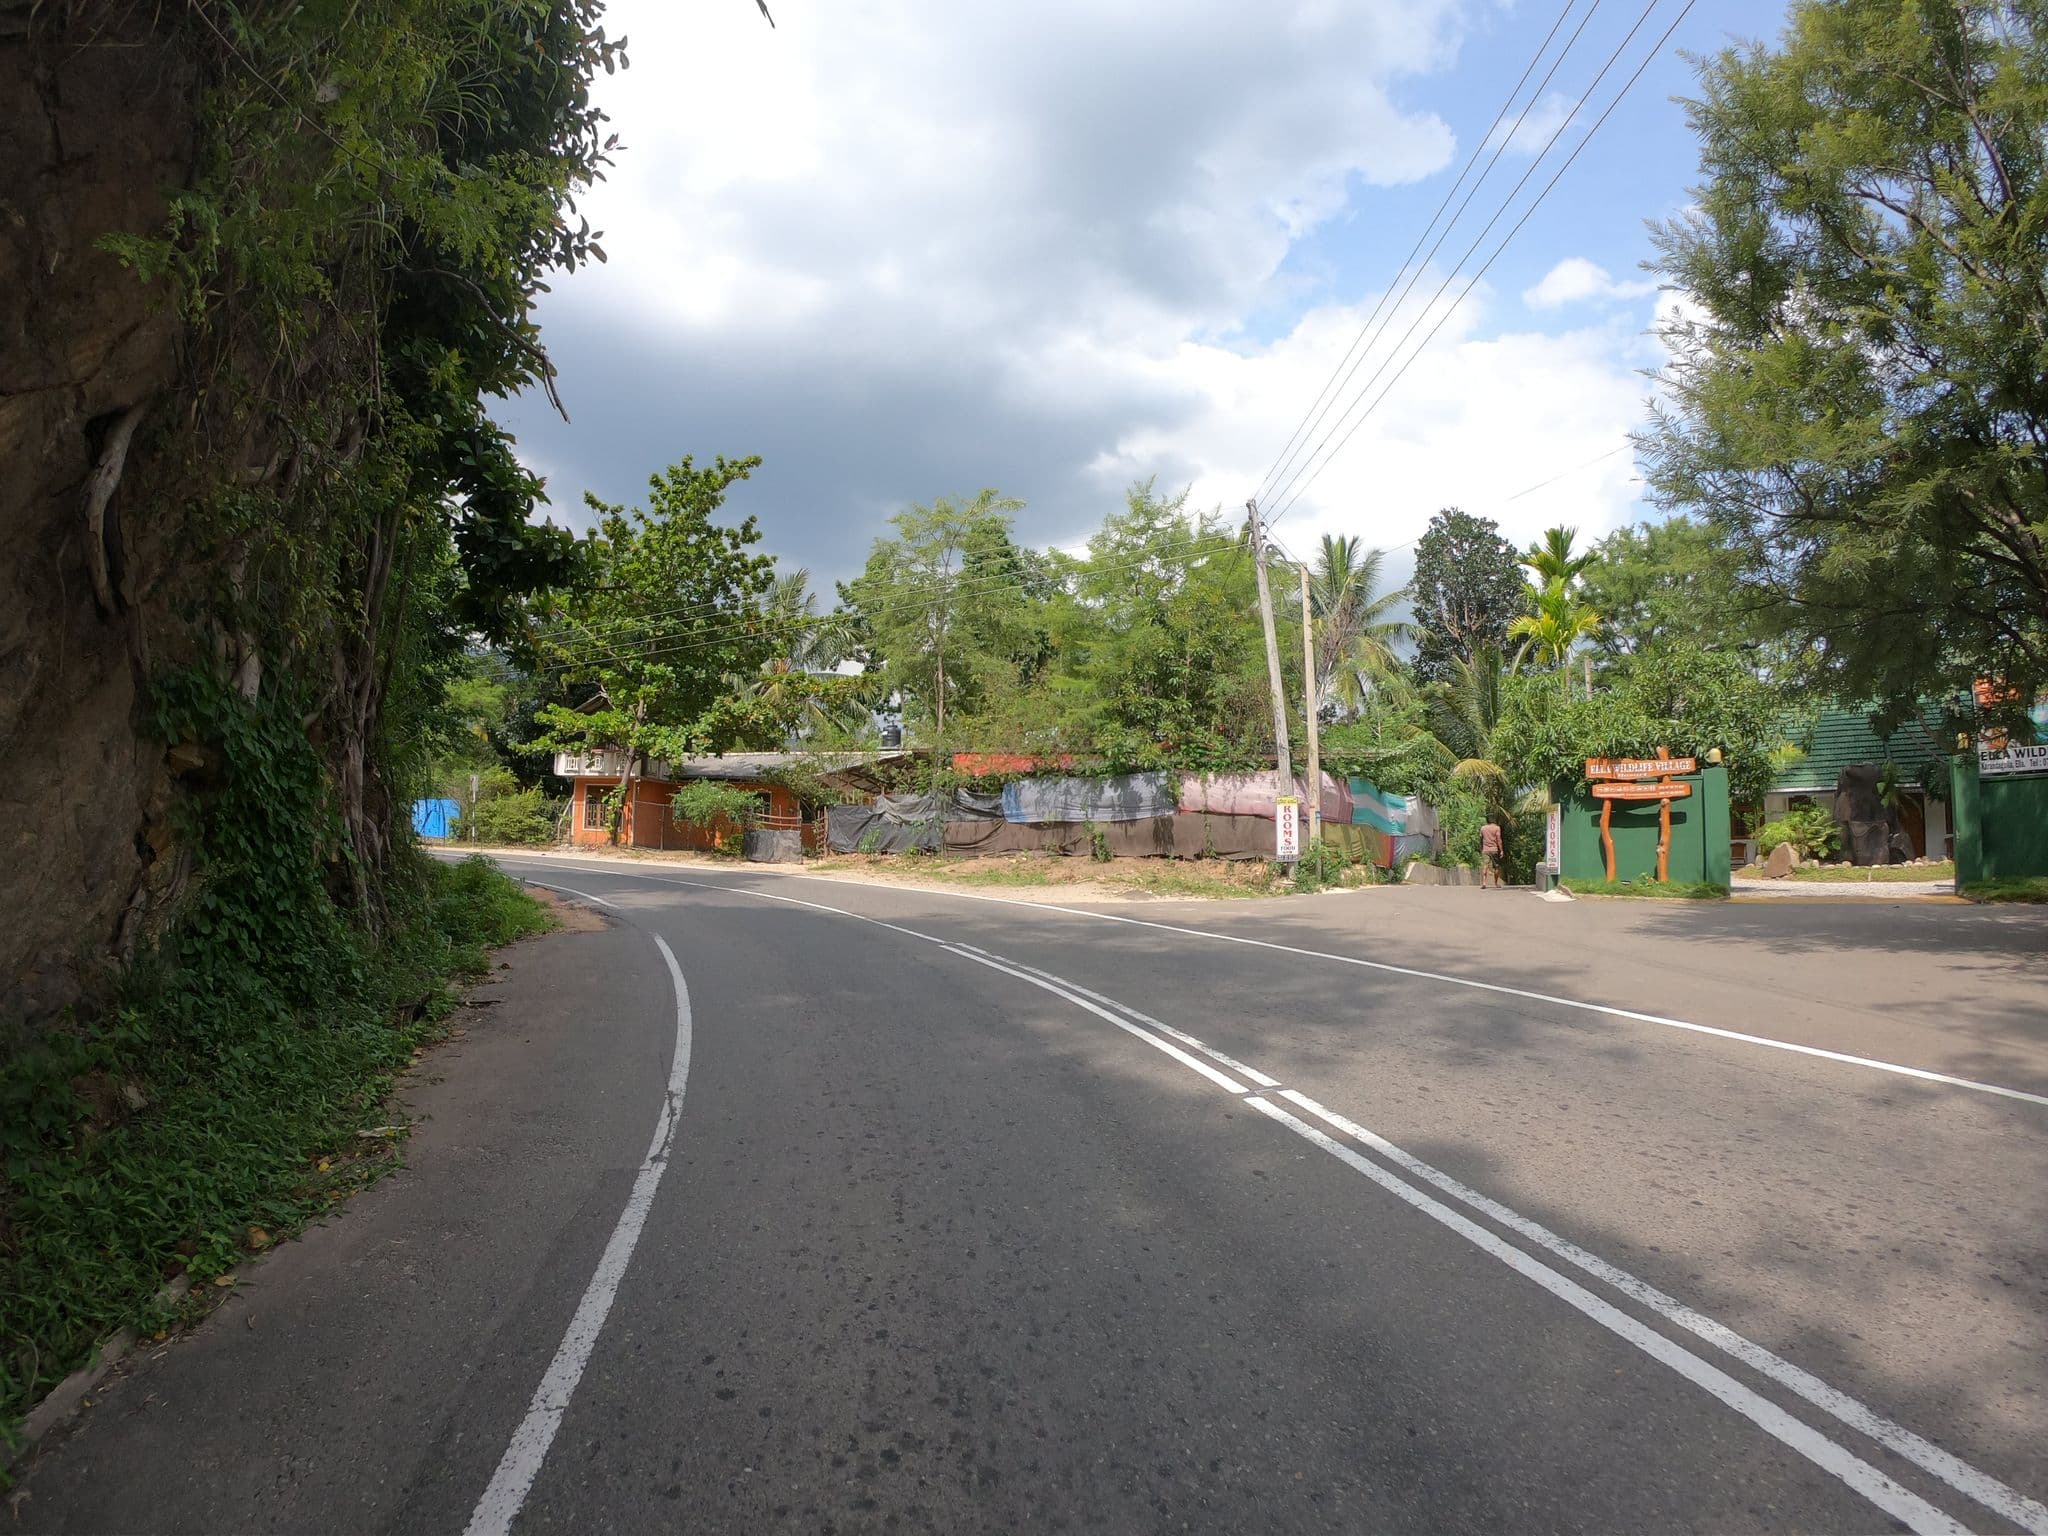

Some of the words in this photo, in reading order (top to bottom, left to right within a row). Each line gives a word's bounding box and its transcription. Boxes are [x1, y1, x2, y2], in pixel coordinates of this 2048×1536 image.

[1590, 764, 1611, 774] ELLA
[1612, 762, 1653, 773] WILDLIFE
[1655, 760, 1691, 771] VILLAGE
[1283, 805, 1293, 846] ROOMS
